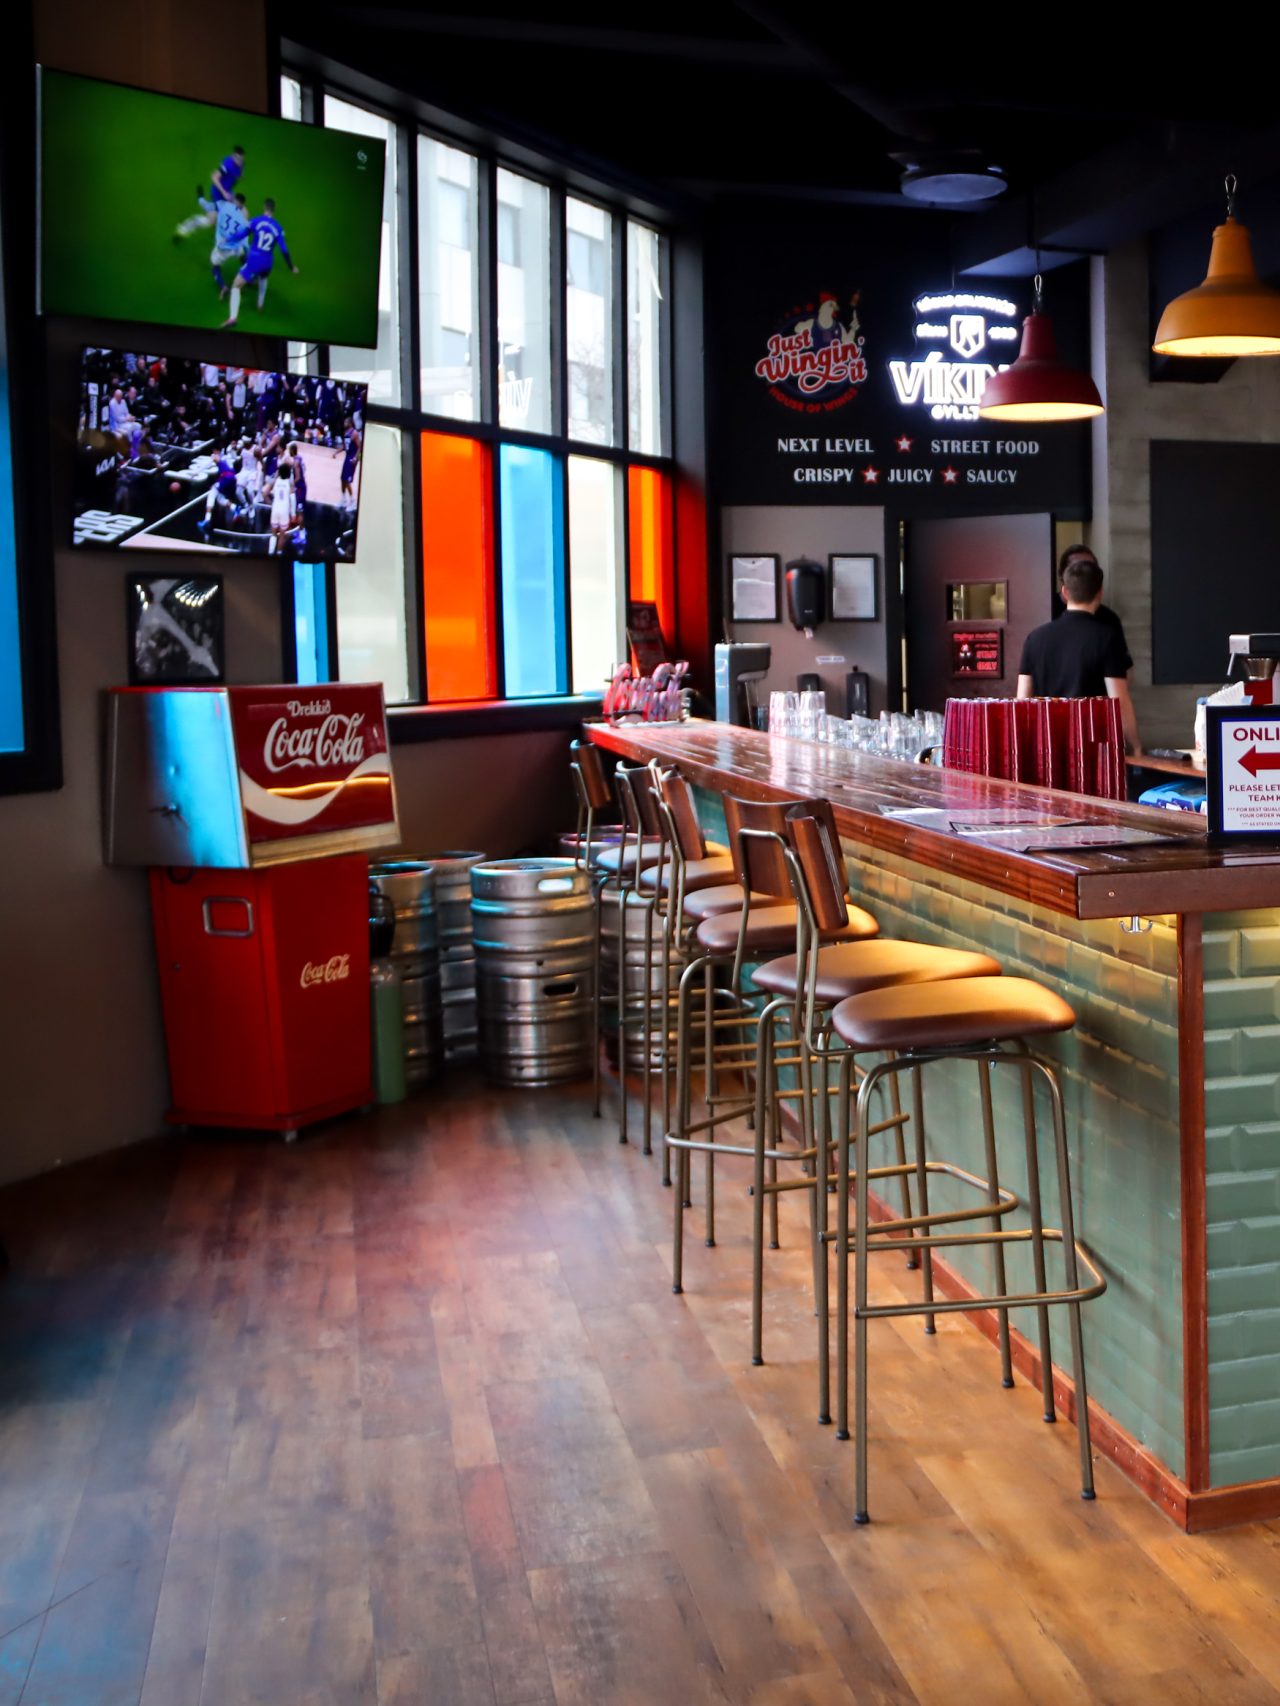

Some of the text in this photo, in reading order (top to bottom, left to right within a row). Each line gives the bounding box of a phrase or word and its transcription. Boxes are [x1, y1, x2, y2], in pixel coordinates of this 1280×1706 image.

[224, 214, 241, 235] 33
[257, 230, 274, 251] 12
[768, 328, 813, 357] Just
[755, 336, 865, 393] Wingin'
[849, 358, 867, 383] it
[889, 351, 1010, 405] VÍKIN
[777, 438, 1040, 455] NEXT LEVEL STREET FOOD
[793, 467, 1017, 484] CRISPY JUICY SAUCY
[287, 699, 332, 717] Drekkið
[264, 712, 366, 773] Coca-Cola
[1229, 784, 1264, 792] PLEASE
[1248, 794, 1276, 802] TEAM
[300, 953, 351, 988] Coca-Cola
